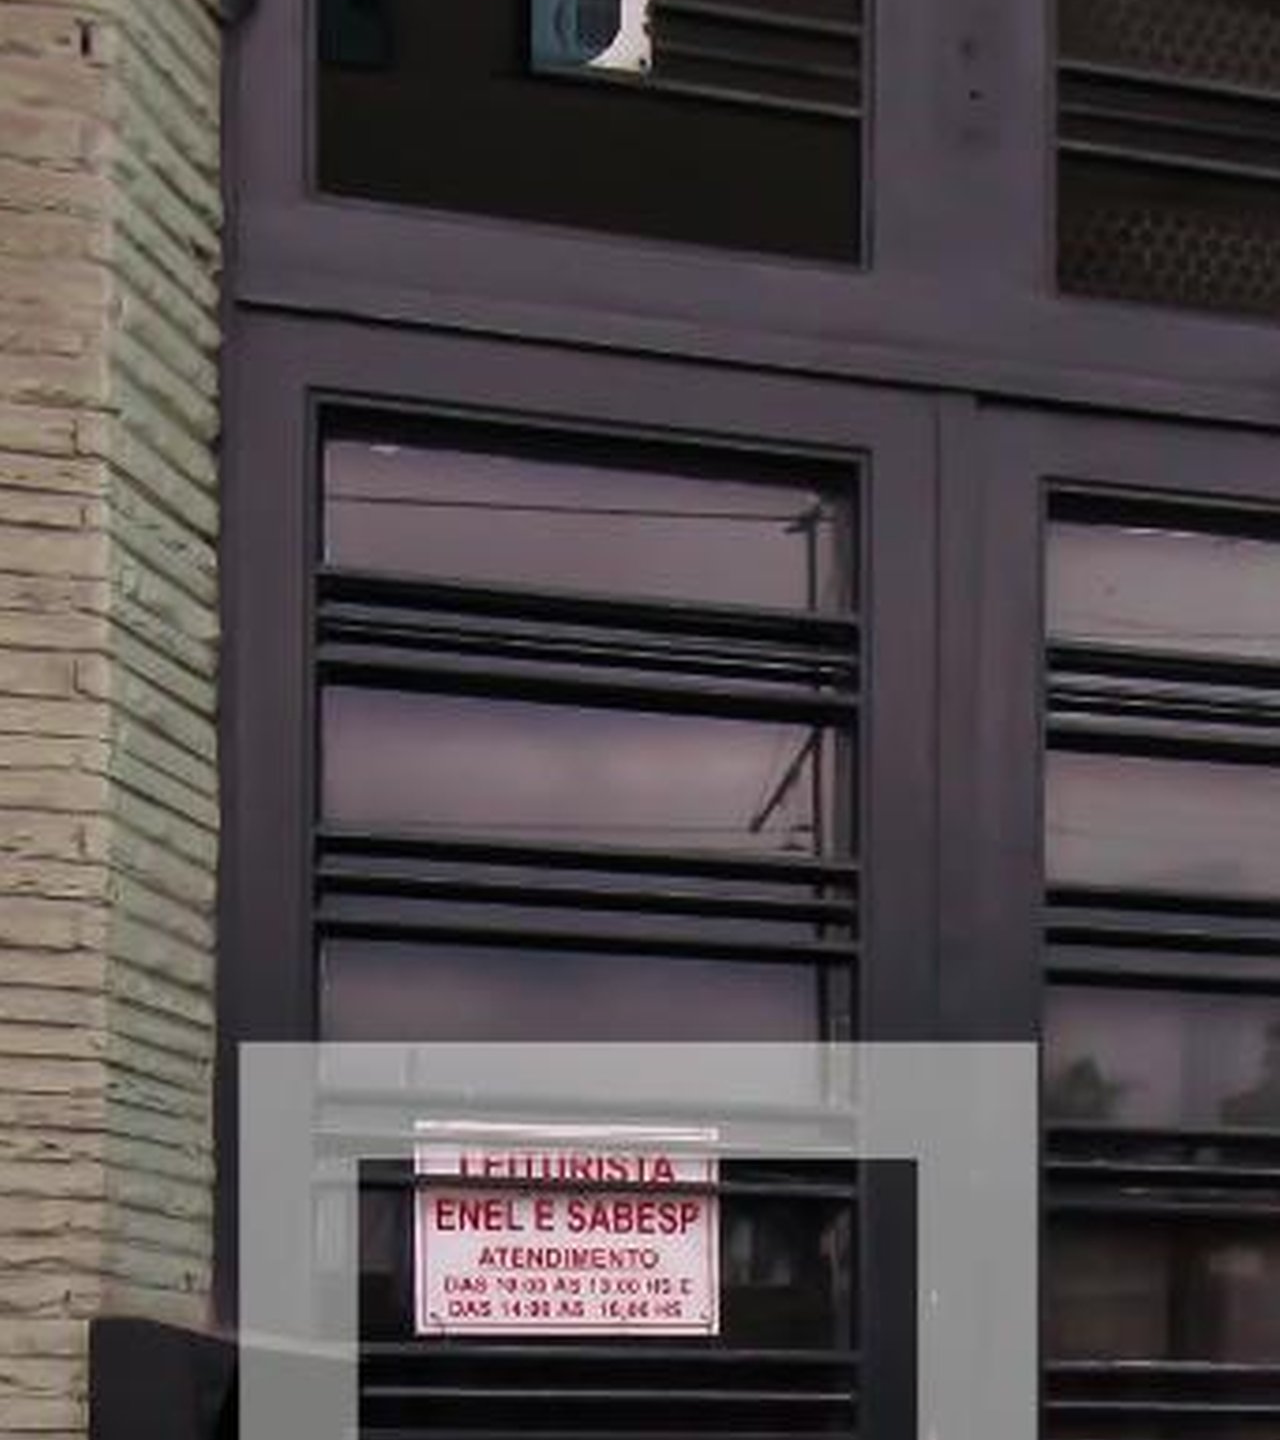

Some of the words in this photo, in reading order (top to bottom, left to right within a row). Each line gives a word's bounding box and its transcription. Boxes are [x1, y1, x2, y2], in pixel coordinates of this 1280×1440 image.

[435, 1197, 524, 1232] ENEL
[534, 1199, 555, 1232] E
[566, 1199, 700, 1235] SABESP
[478, 1246, 660, 1270] ATENDIMENTO
